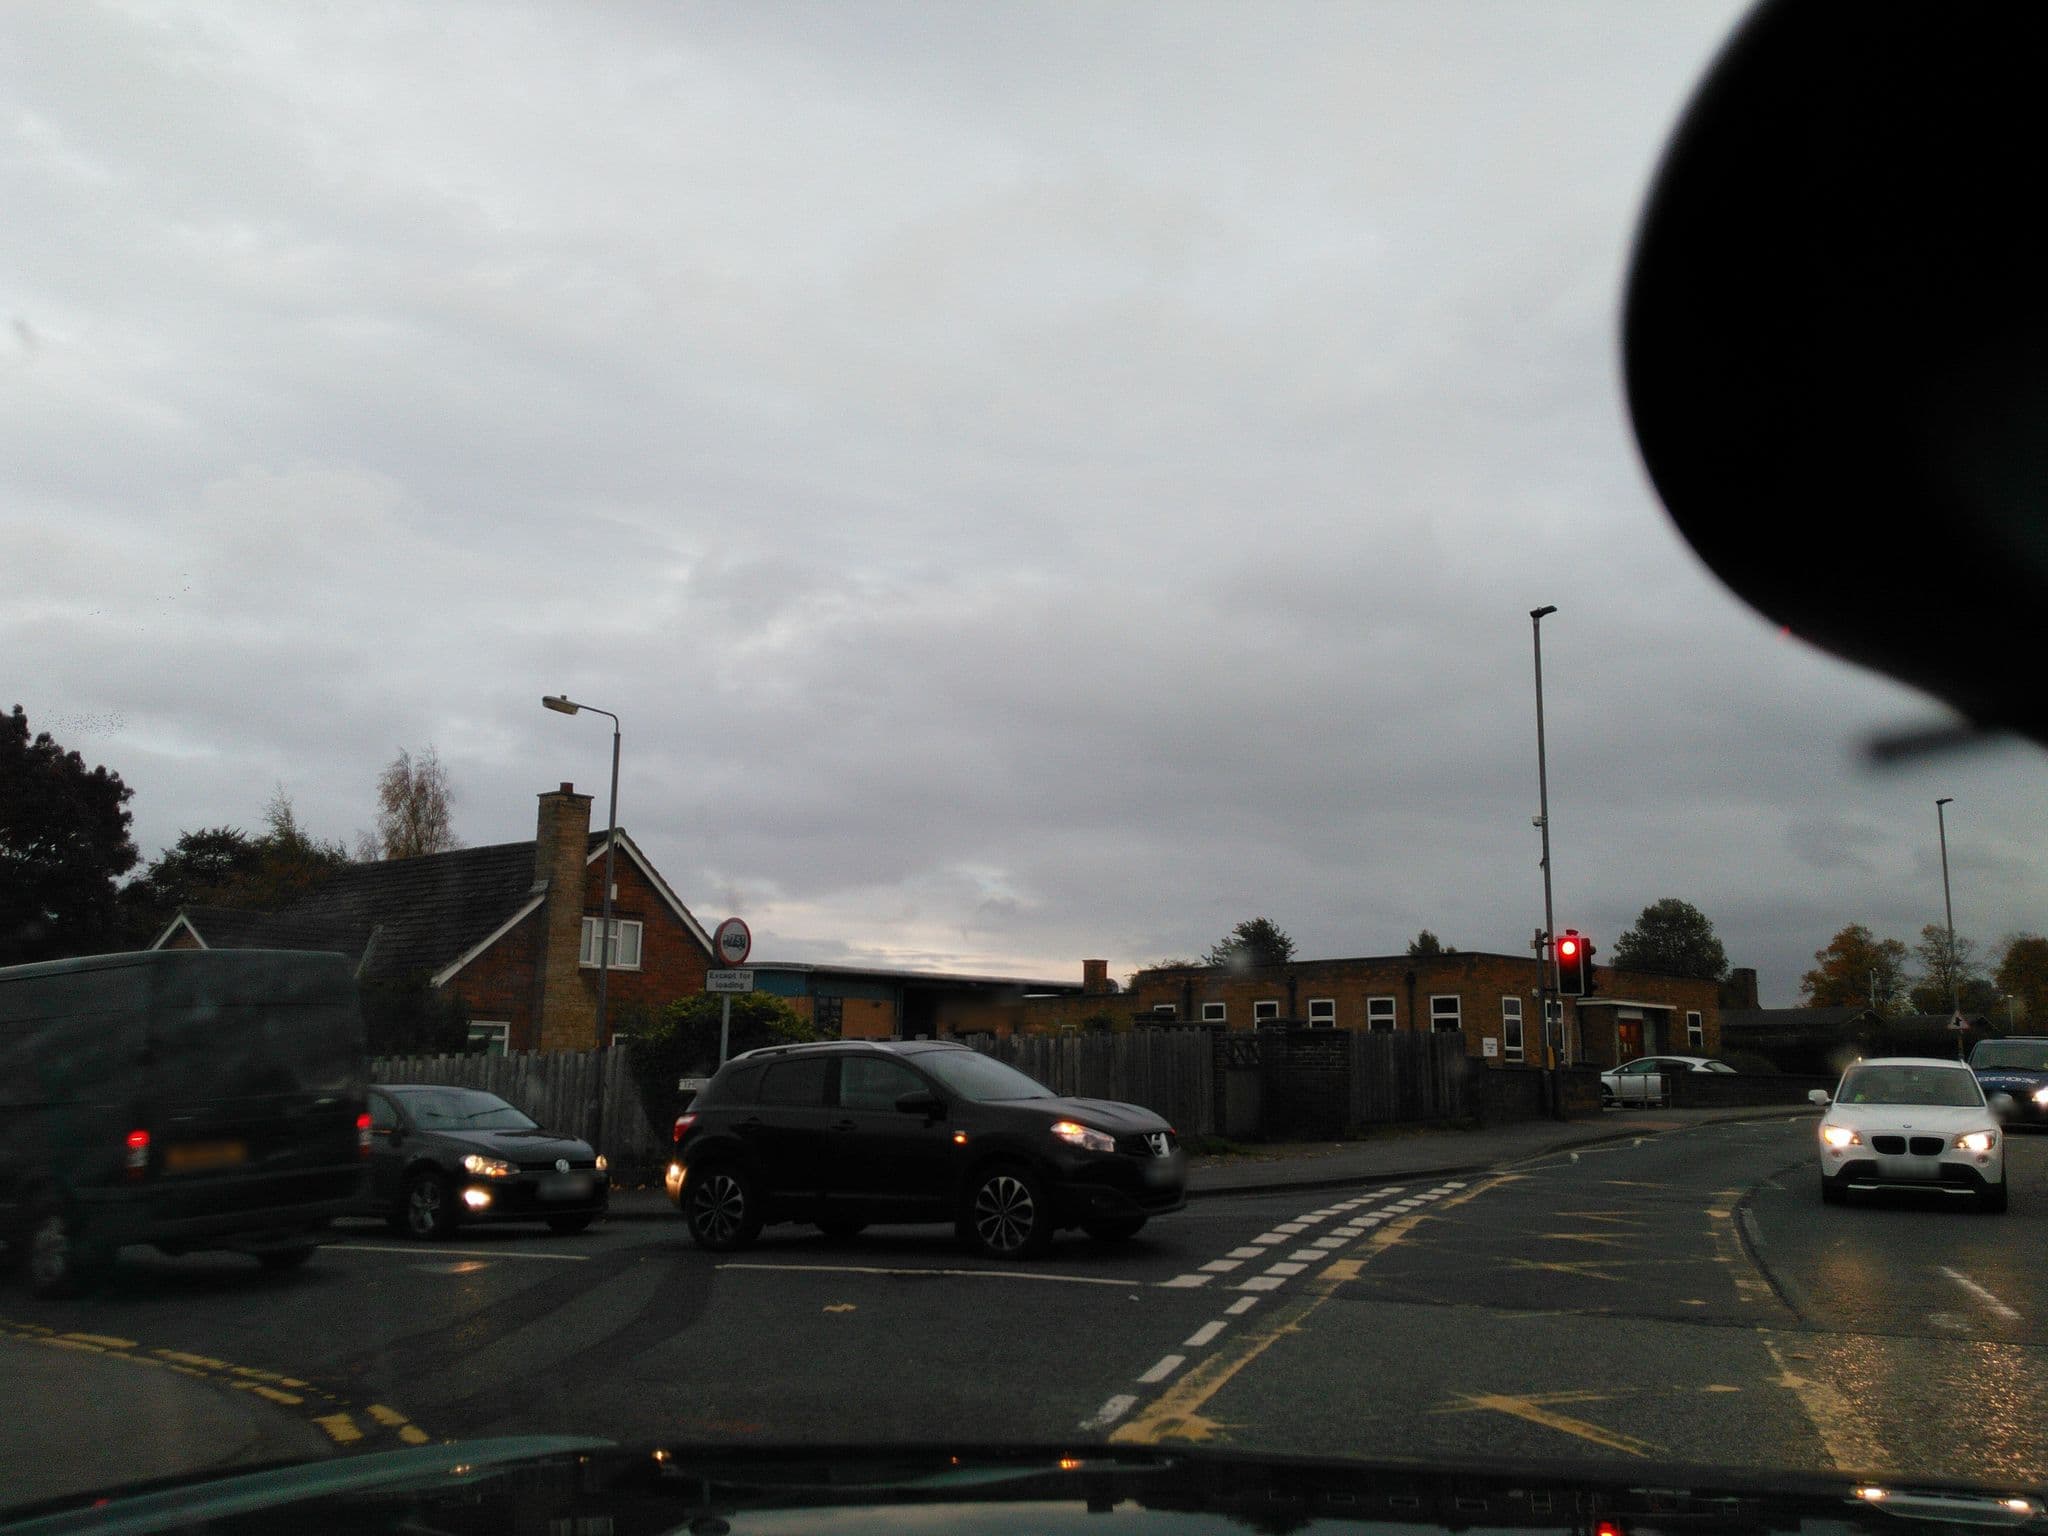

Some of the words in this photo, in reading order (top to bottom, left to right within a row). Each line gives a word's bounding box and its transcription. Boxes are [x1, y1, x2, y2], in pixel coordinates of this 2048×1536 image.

[709, 971, 736, 980] Except
[740, 972, 752, 980] for
[715, 981, 744, 990] loading
